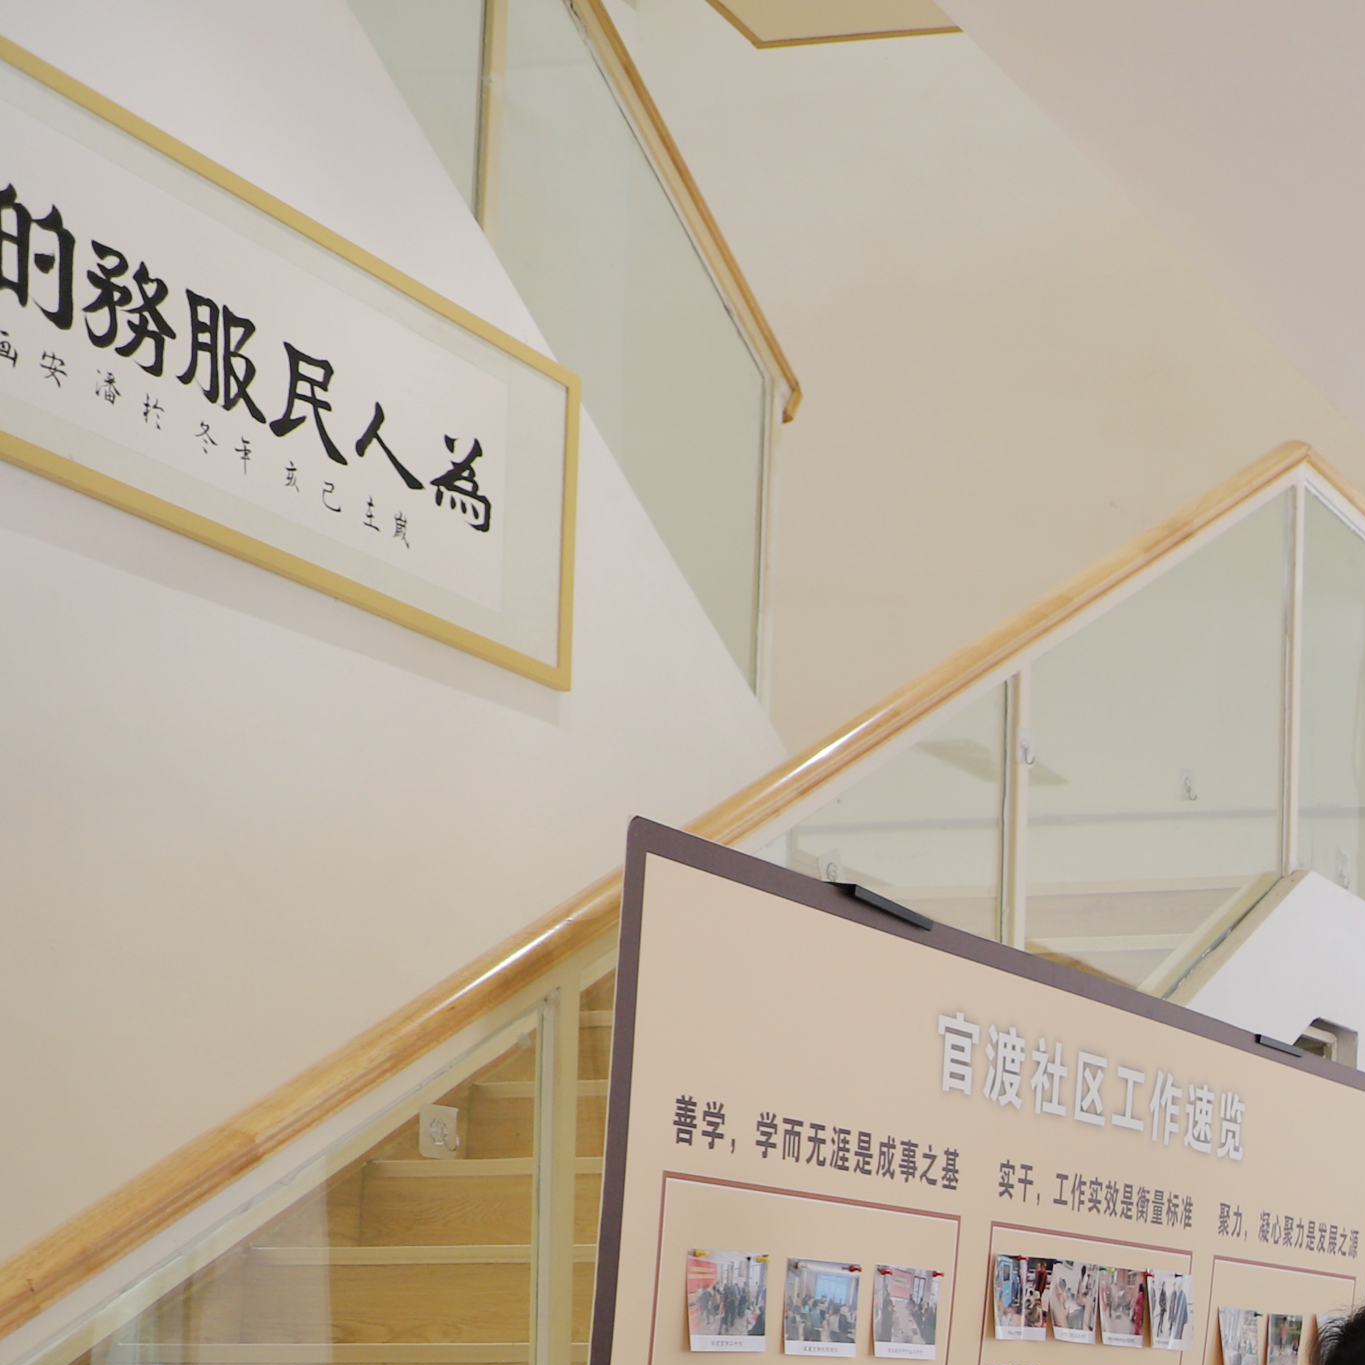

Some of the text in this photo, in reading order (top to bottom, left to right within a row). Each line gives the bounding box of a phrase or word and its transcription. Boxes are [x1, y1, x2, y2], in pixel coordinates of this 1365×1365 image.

[938, 1011, 1246, 1161] 官渡社区工作速览
[673, 1094, 960, 1190] 善学，学而无涯是成事之基
[998, 1159, 1194, 1230] 实干，工作实效是衡量标准
[1217, 1202, 1360, 1259] 聚力，凝心聚力是发展之源
